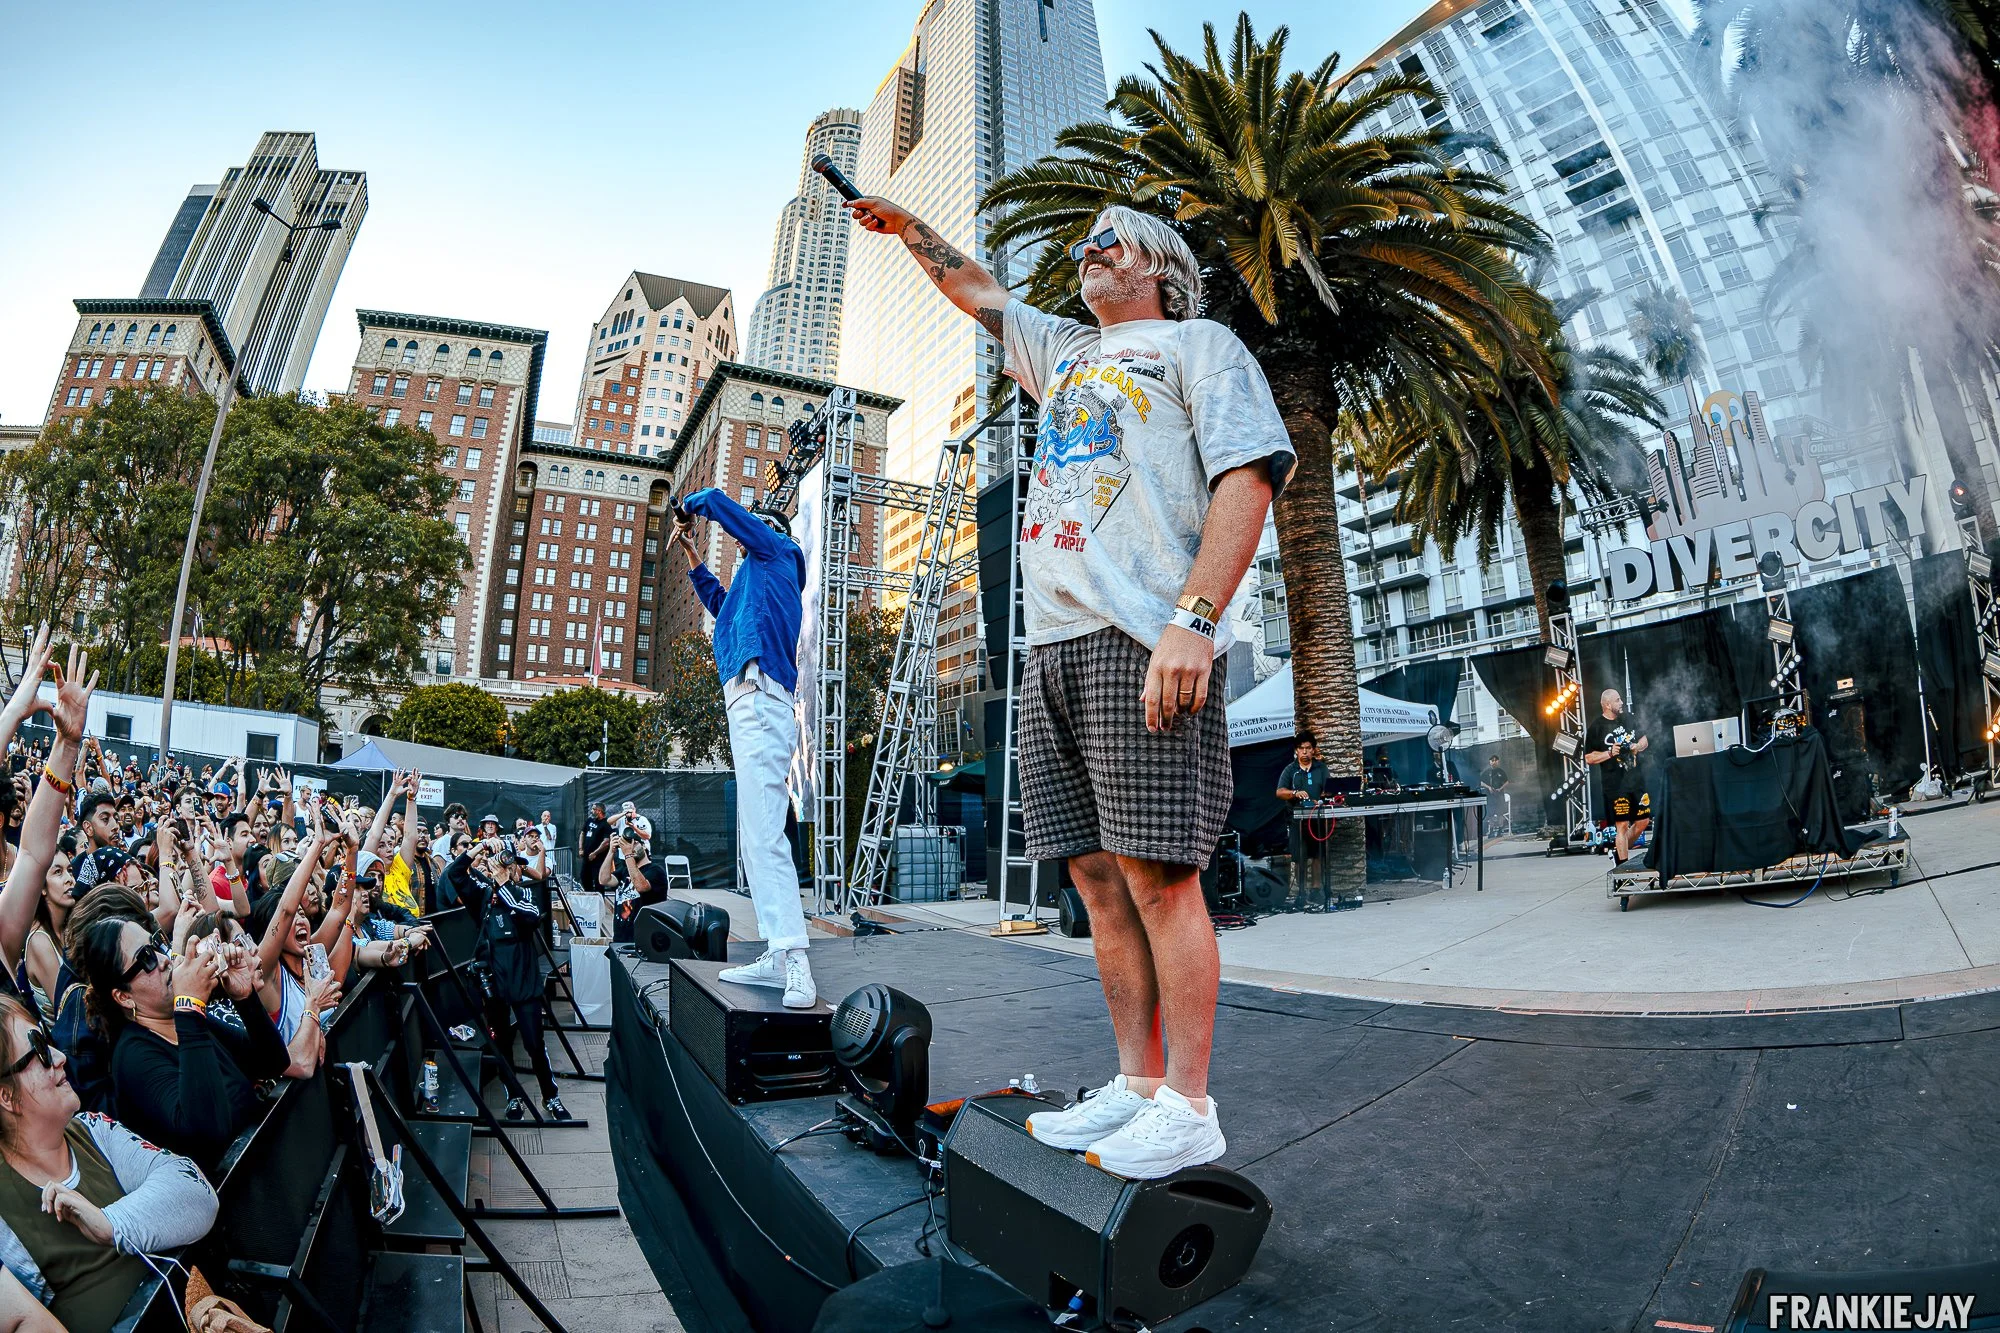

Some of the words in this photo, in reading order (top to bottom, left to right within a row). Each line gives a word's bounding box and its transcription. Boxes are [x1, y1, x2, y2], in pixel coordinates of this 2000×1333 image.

[1100, 365, 1152, 424] GAME
[1094, 475, 1121, 489] JUNE
[1607, 474, 1928, 602] DIVERCITY
[1239, 717, 1268, 728] ANGELES
[1263, 723, 1277, 732] AND
